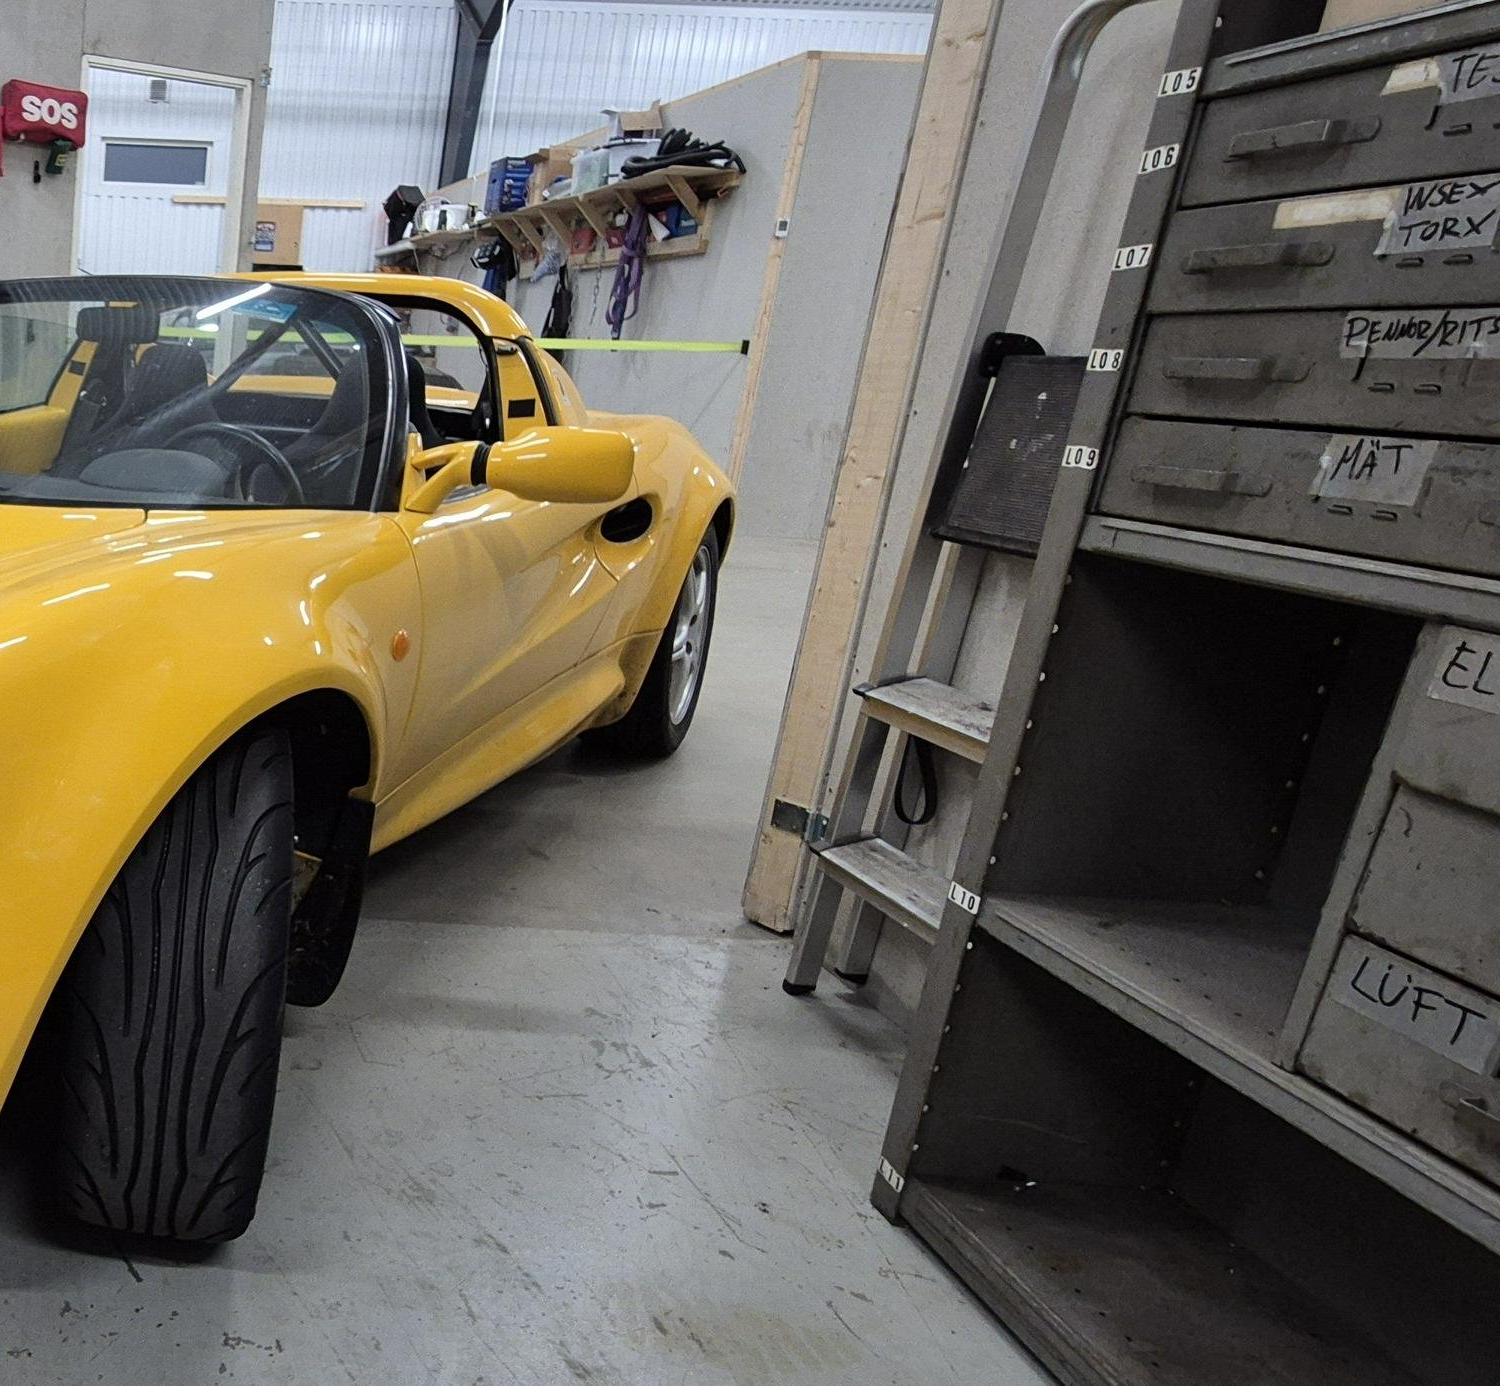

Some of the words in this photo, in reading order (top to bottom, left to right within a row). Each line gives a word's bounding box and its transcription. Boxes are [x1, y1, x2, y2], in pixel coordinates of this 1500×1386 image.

[1451, 53, 1500, 93] TE
[21, 95, 78, 129] SOS
[1403, 181, 1500, 216] INSEX
[1398, 208, 1497, 247] TORX
[1329, 438, 1414, 481] MÄT
[1442, 640, 1495, 695] EL
[950, 884, 976, 911] L10
[1351, 956, 1488, 1046] LÜFT
[880, 1158, 901, 1190] L11
